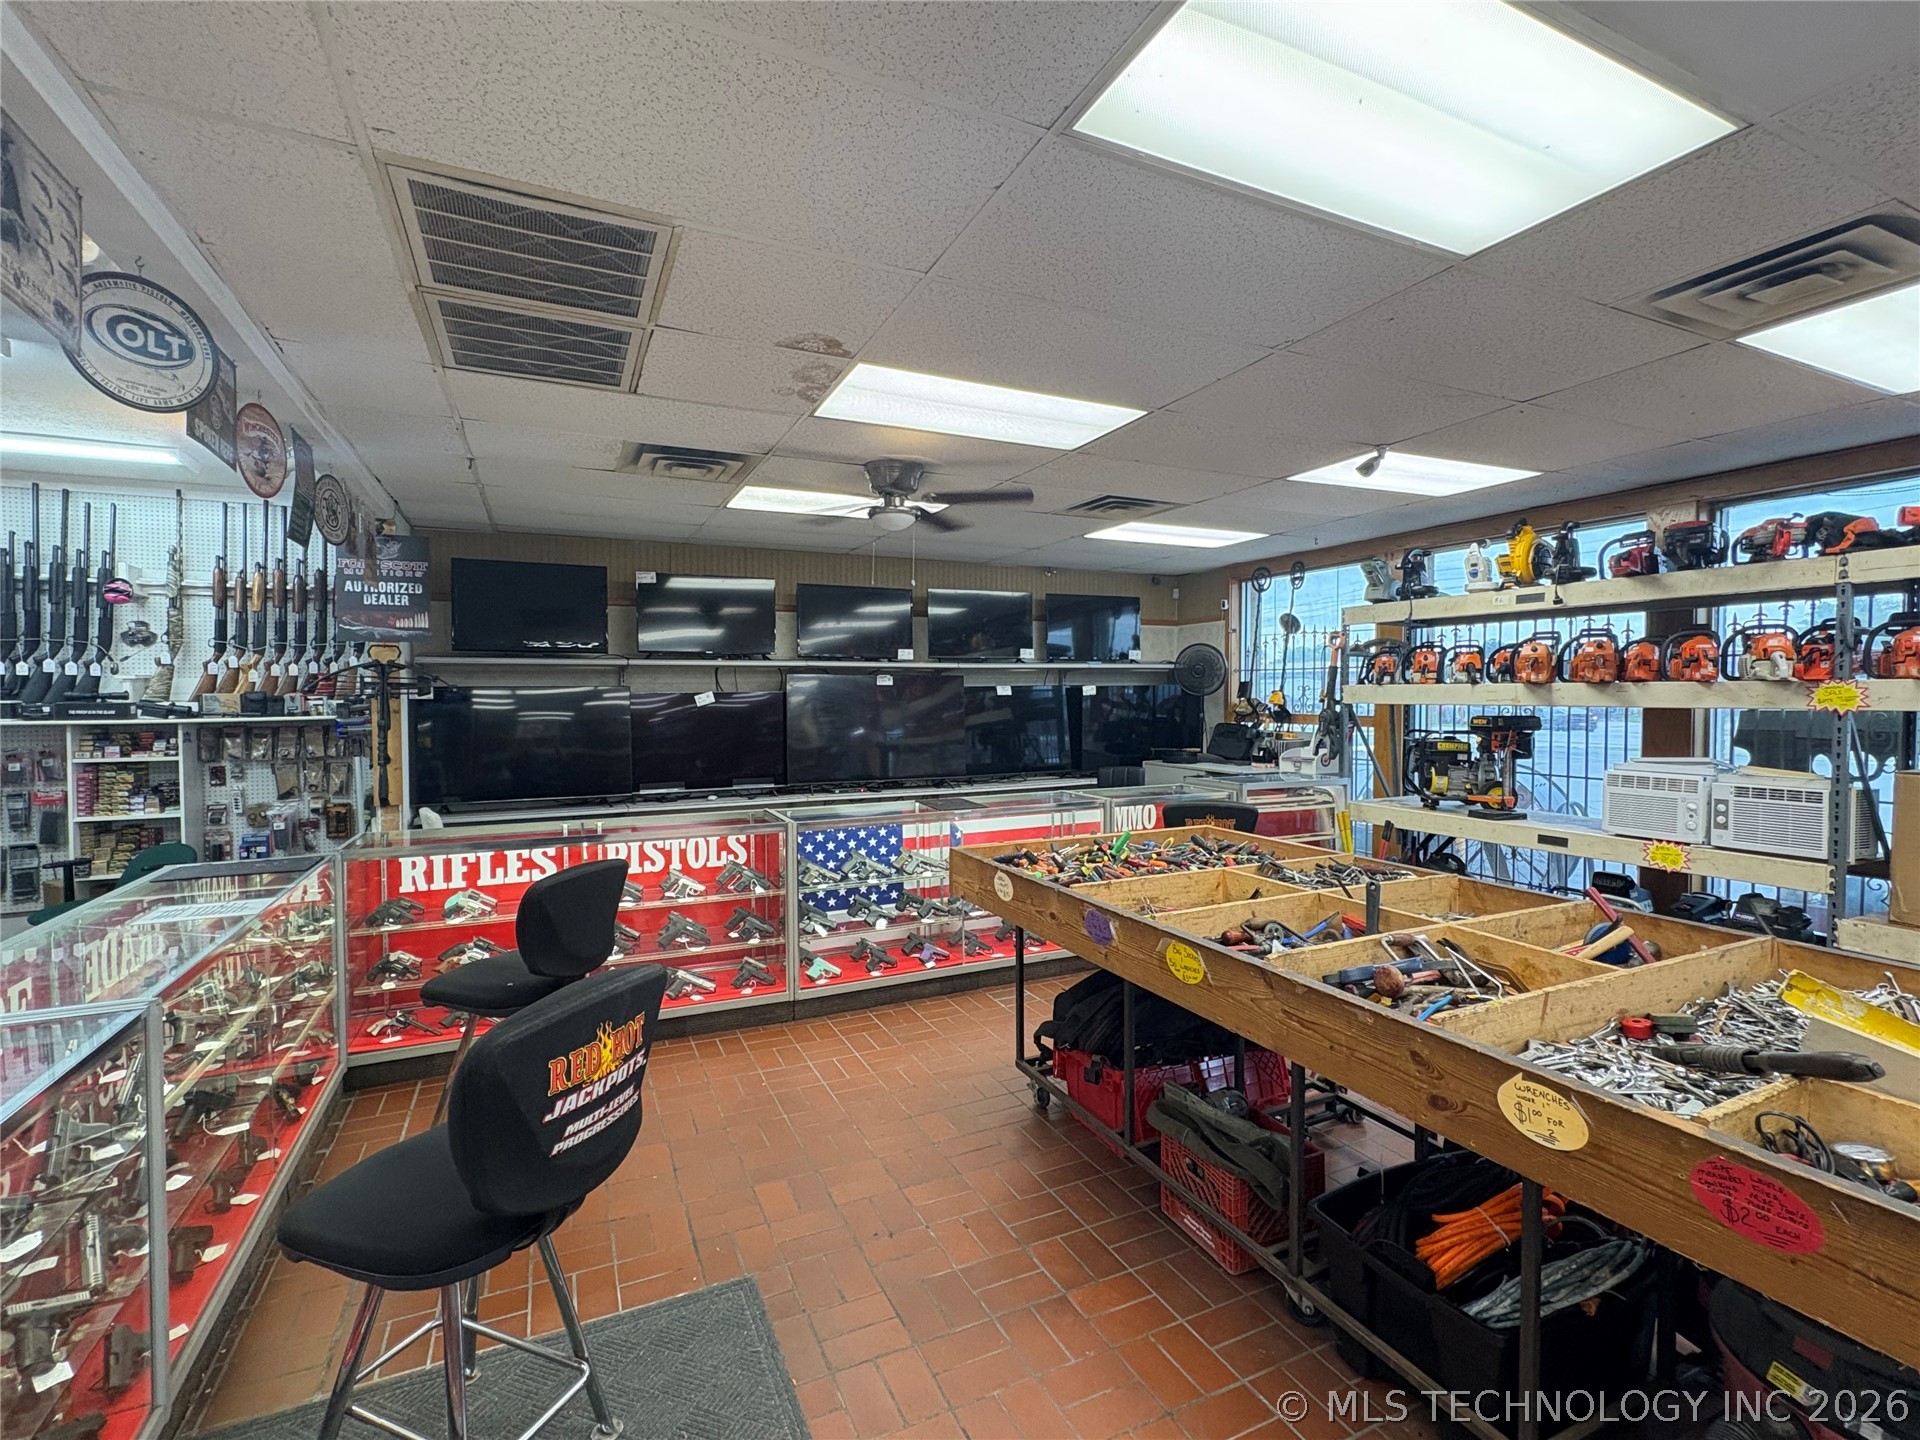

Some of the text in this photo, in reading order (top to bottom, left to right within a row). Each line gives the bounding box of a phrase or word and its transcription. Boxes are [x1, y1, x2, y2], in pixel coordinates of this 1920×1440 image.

[91, 306, 191, 366] COLT
[338, 558, 429, 571] FO SCOTT
[343, 568, 424, 577] MUITIONS
[363, 593, 409, 606] DEALER
[1436, 741, 1469, 752] CHAMPION
[1114, 804, 1157, 832] MMO
[398, 834, 748, 893] RIFLES PISTOLS
[548, 1011, 646, 1096] RED HOT
[563, 1083, 635, 1138] MULTI-LEVEL
[1514, 1082, 1571, 1111] WRENCHES
[549, 1090, 640, 1157] PROGRESSIVES
[1547, 1117, 1565, 1128] FOR
